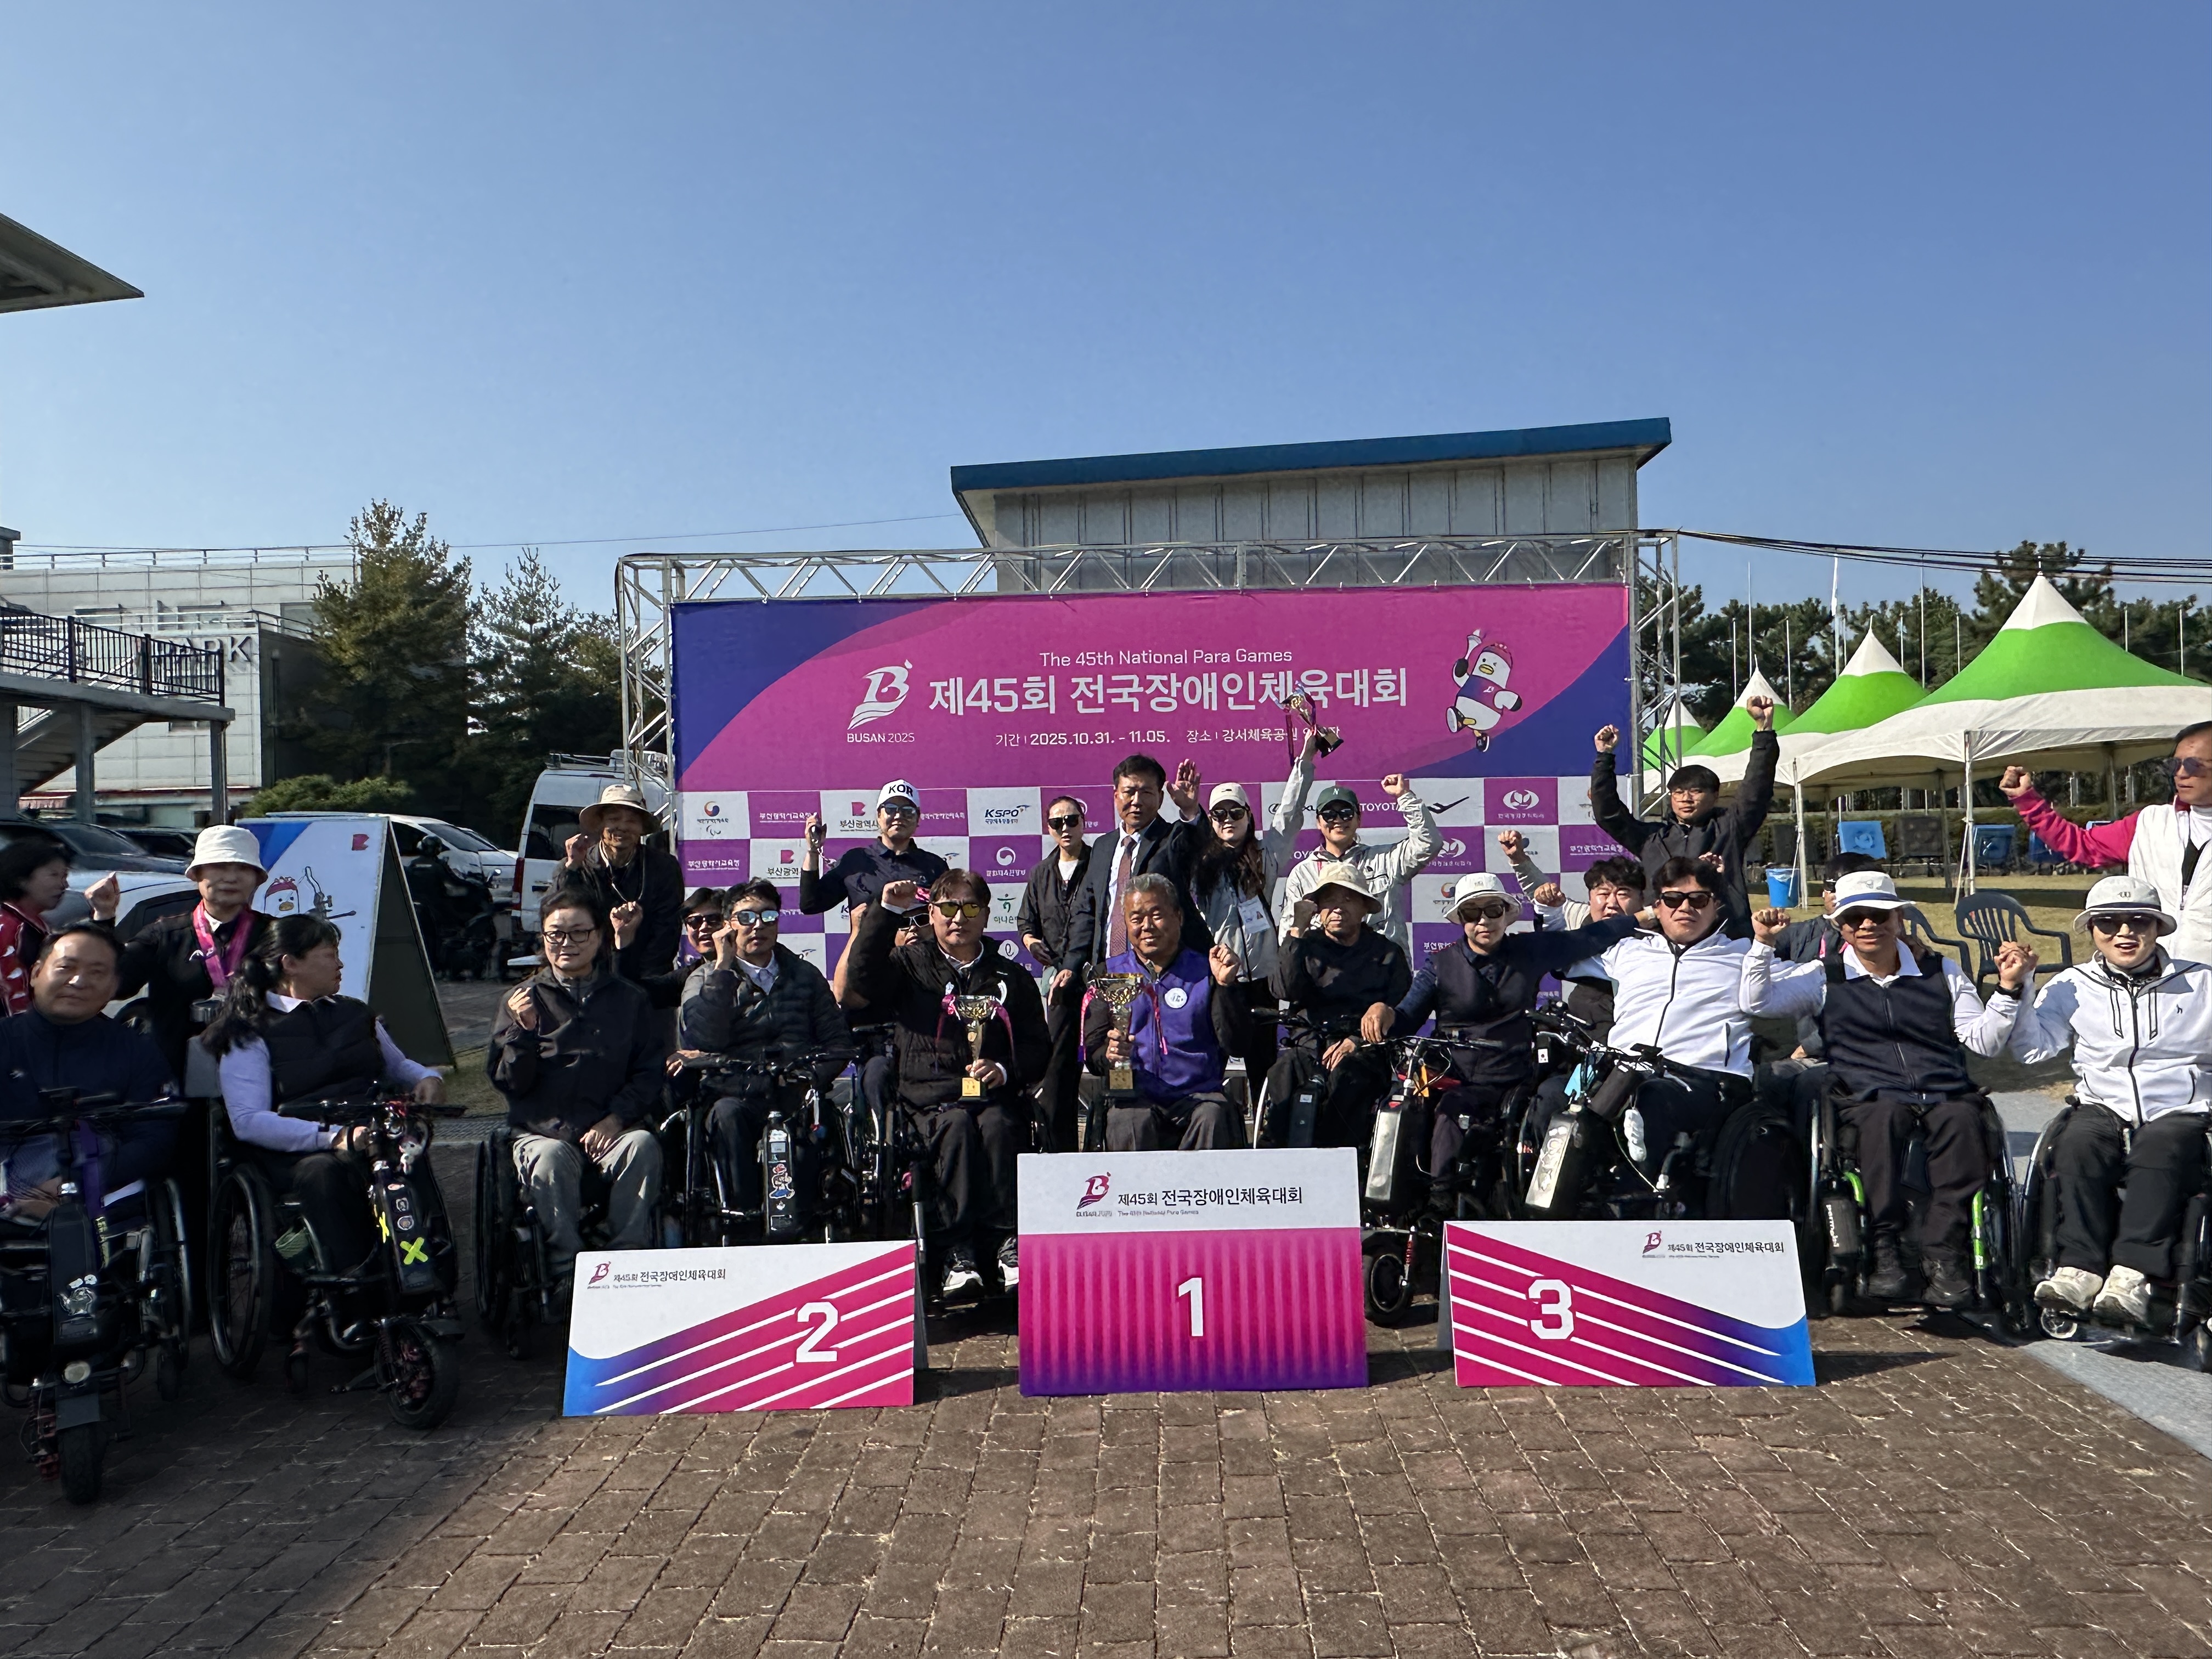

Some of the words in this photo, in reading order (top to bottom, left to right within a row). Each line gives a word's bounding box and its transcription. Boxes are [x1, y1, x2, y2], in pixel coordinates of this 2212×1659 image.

[1040, 652, 1070, 667] The
[1076, 651, 1114, 666] 45th
[1119, 650, 1187, 665] National
[1194, 650, 1231, 664] Para
[1236, 648, 1292, 663] Games
[929, 675, 1056, 715] 제45회
[1070, 668, 1406, 714] 전국장애인체육대회
[847, 733, 885, 743] BUSAN
[888, 732, 915, 743] 2025
[996, 733, 1020, 747] 기간
[1030, 731, 1114, 746] 2025.10.31.
[1131, 730, 1170, 743] 11.05.
[1186, 730, 1212, 743] 장소
[889, 784, 913, 797] KOR
[985, 809, 1019, 817] KSPO
[1359, 803, 1399, 812] TOYOT
[1118, 1193, 1158, 1206] 제45회
[1161, 1187, 1302, 1206] 전국장애인체육대회
[1178, 1277, 1204, 1337] 1
[1528, 1279, 1575, 1340] 3
[795, 1301, 839, 1363] 2
